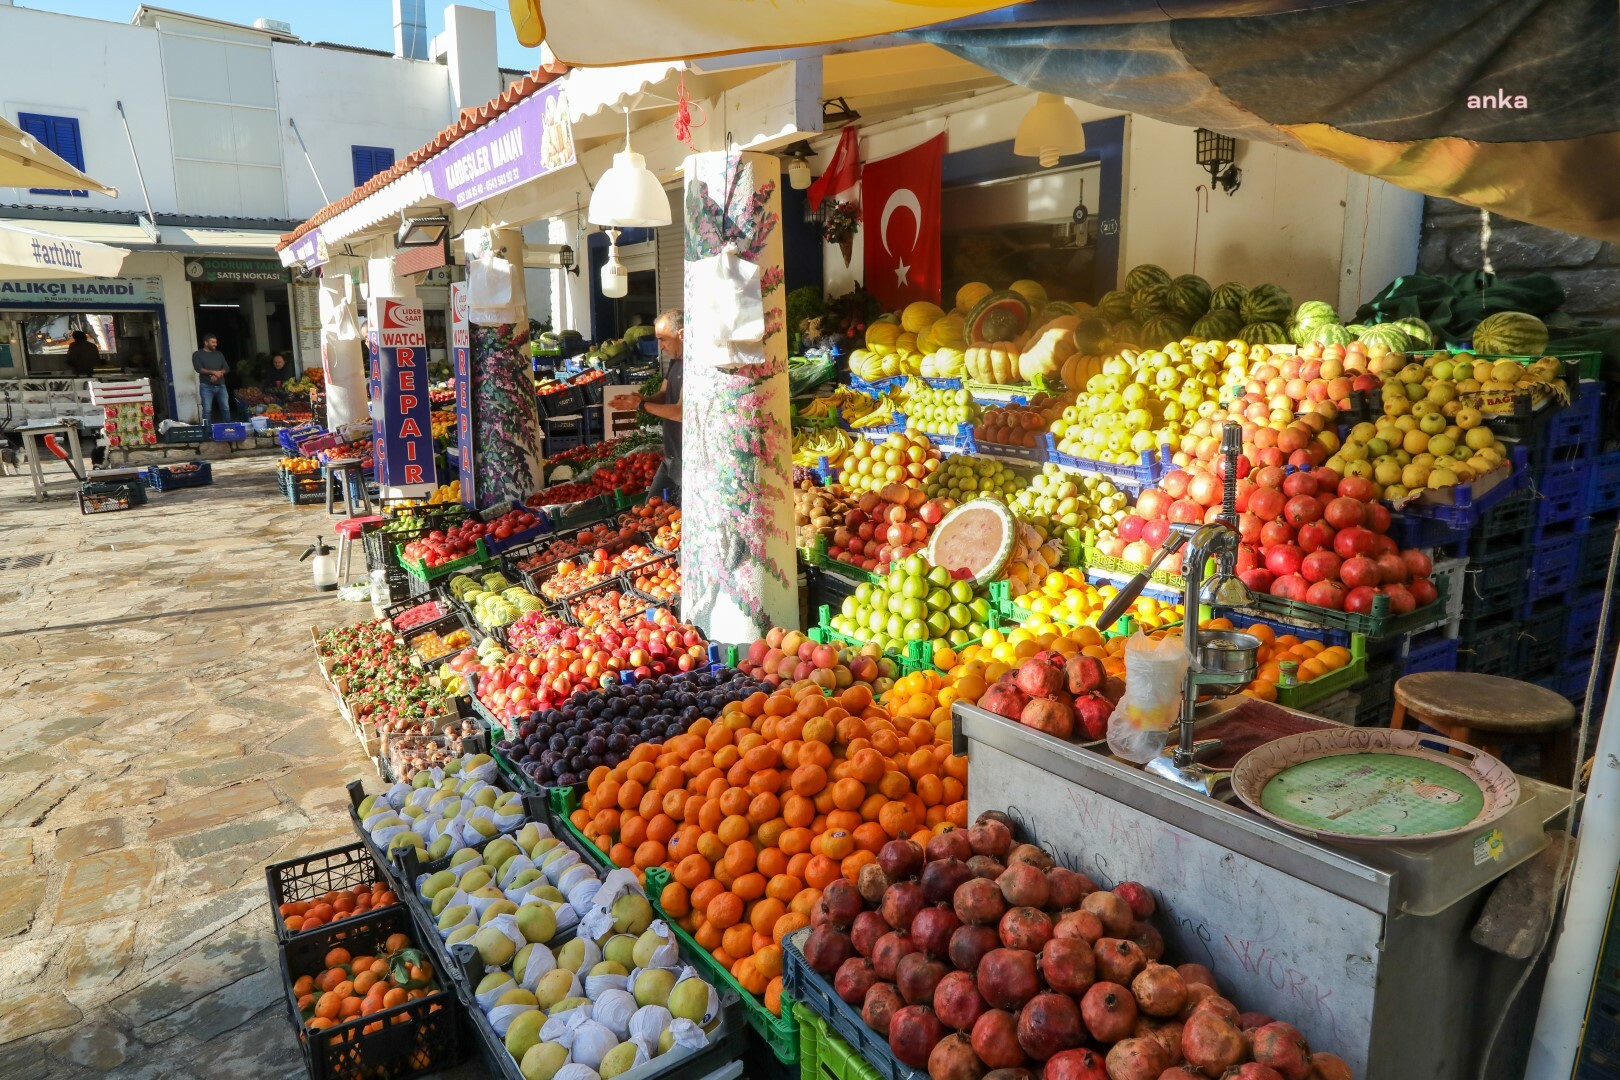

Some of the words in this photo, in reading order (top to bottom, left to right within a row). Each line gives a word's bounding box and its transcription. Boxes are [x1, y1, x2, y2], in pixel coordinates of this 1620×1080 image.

[490, 126, 523, 169] MANAV
[204, 261, 253, 270] BODRUM
[217, 271, 240, 280] SATIŞ
[243, 272, 280, 280] NOKTASI
[72, 282, 134, 295] HAMDİ
[382, 333, 425, 346] WATCH
[396, 347, 425, 485] REPAIR
[1223, 934, 1338, 1042] WORK
